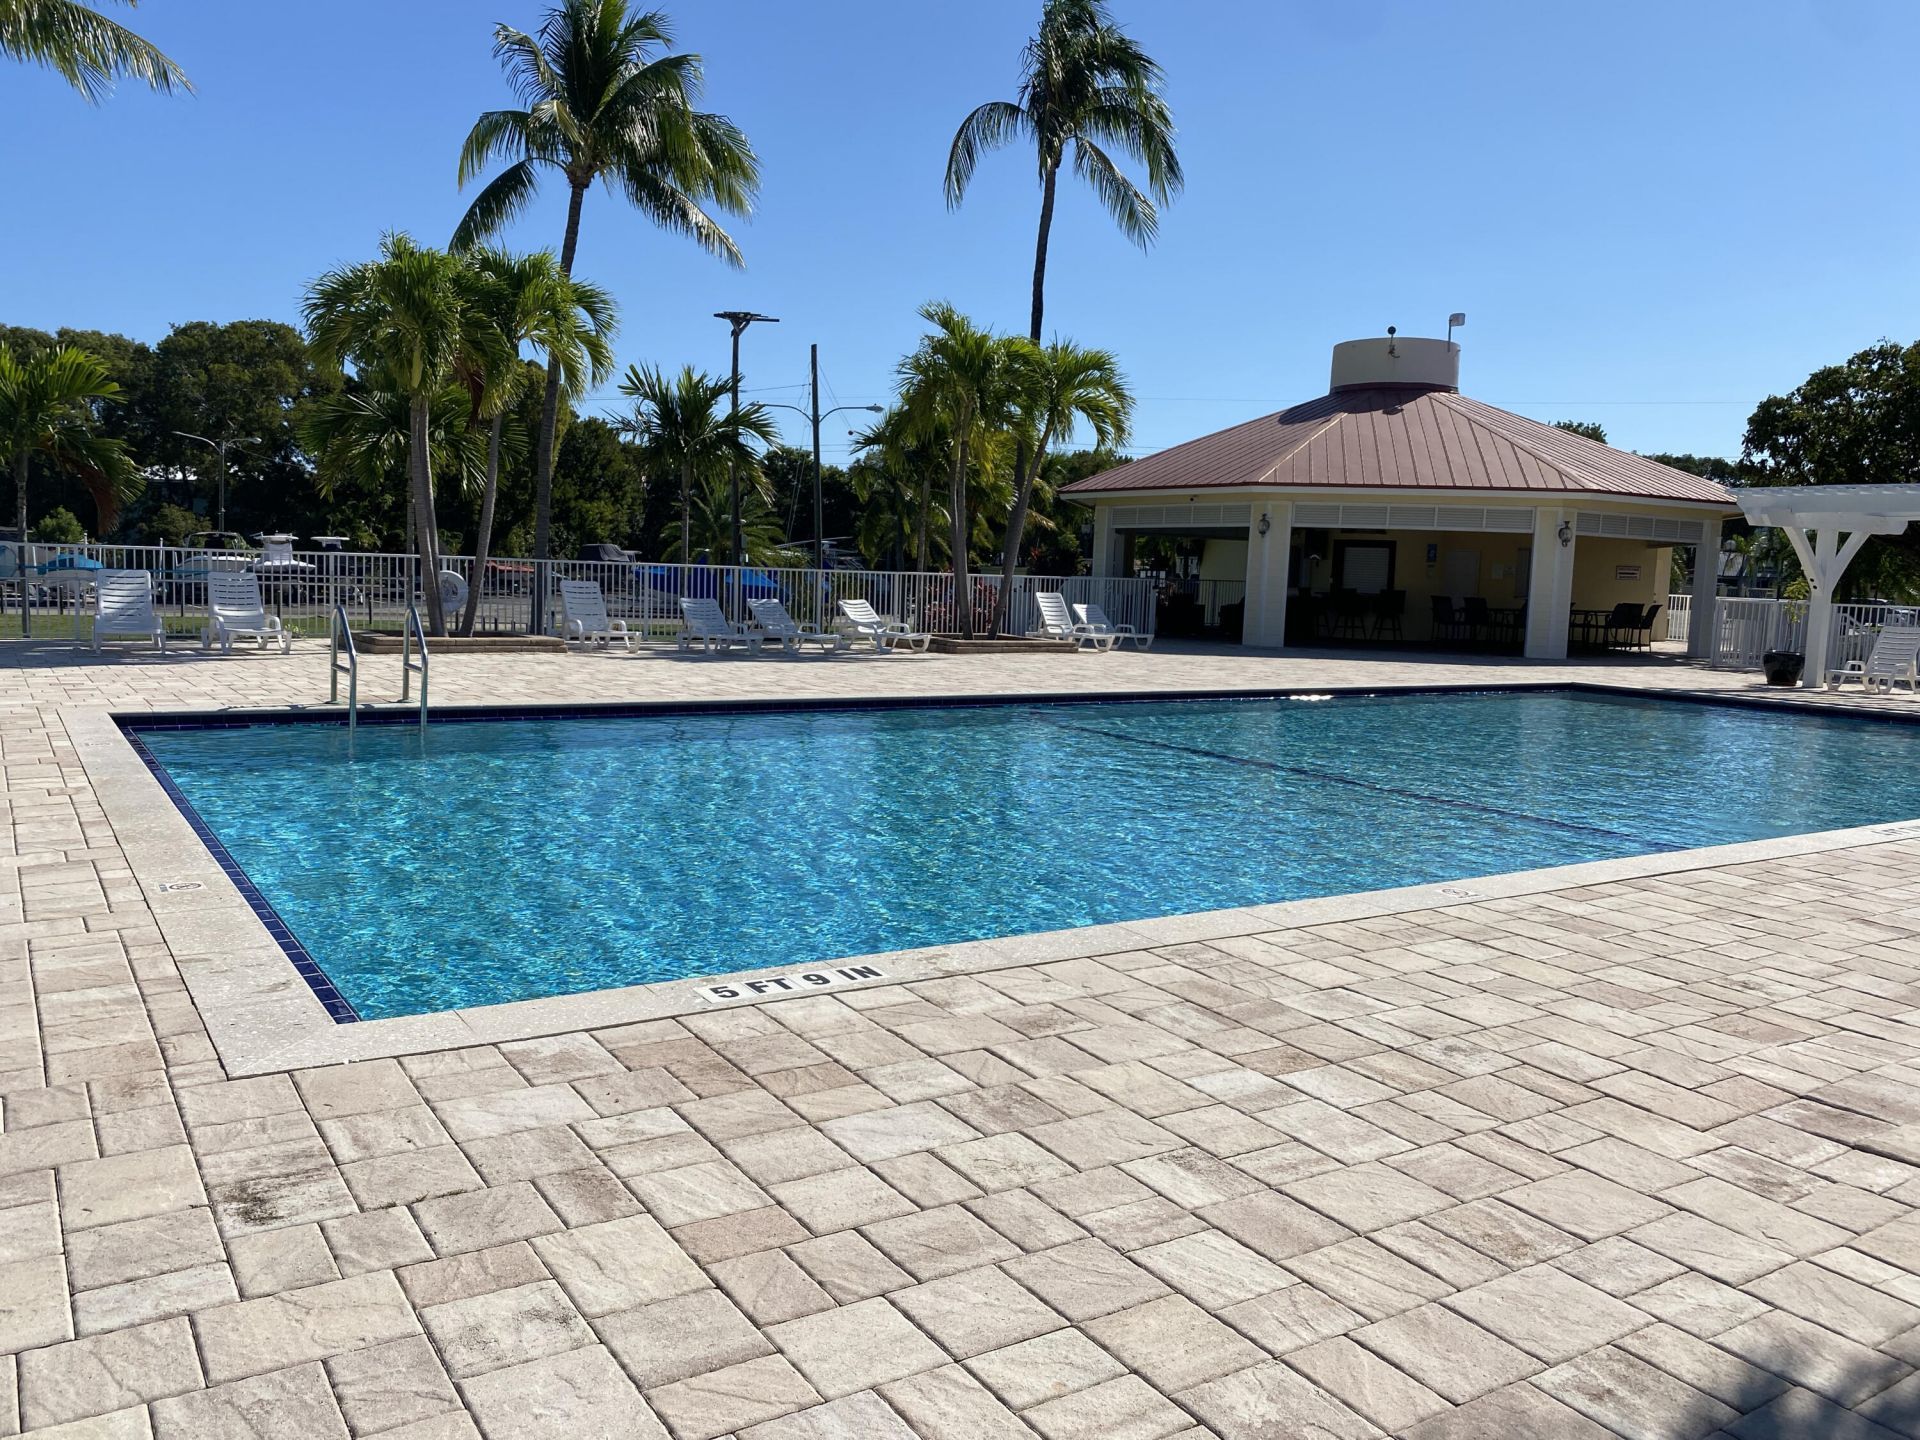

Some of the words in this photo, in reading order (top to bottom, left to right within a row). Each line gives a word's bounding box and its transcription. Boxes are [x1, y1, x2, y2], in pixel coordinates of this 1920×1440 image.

[709, 986, 740, 998] 5
[745, 977, 793, 994] FT
[802, 973, 831, 986] 9
[836, 966, 882, 981] IN
